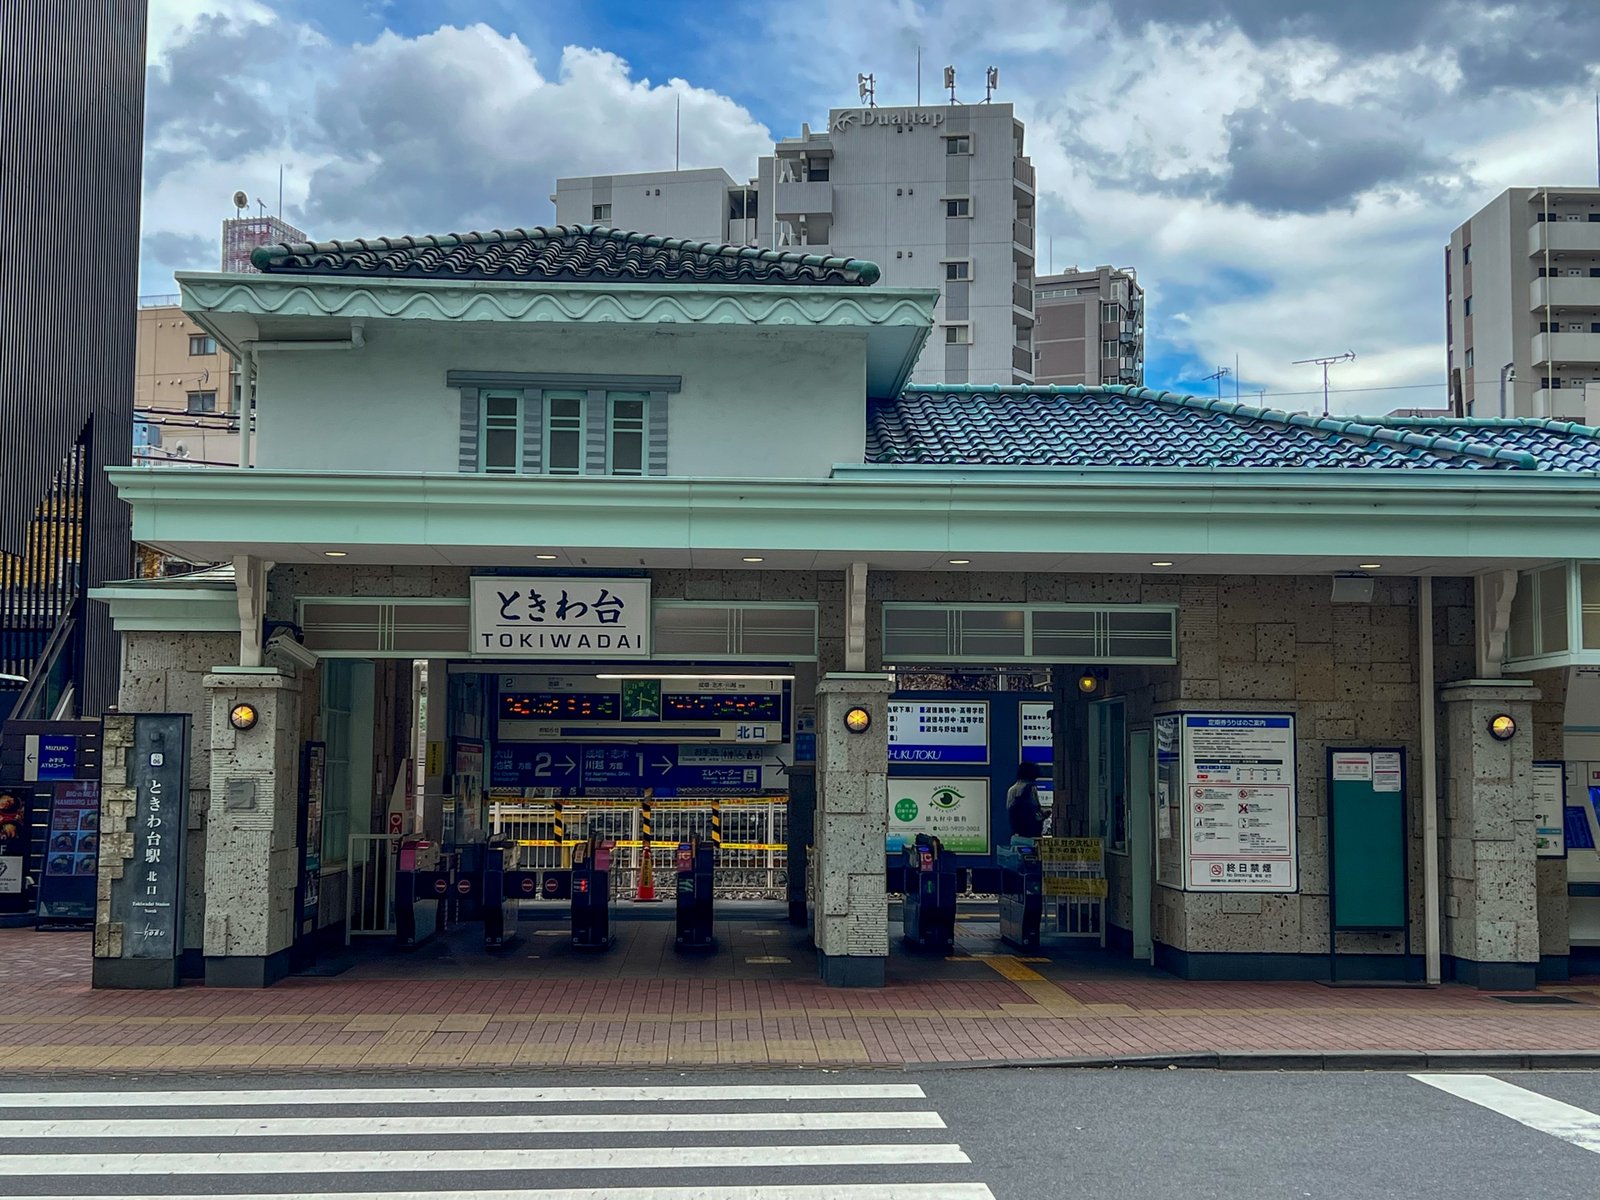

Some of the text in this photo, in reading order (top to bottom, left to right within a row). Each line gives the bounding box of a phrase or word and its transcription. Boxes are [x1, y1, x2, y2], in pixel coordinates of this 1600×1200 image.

[860, 110, 945, 127] Dualtap
[496, 588, 625, 624] ときわ台
[481, 633, 642, 649] TOKIWADAI
[505, 678, 513, 688] 2
[769, 680, 774, 689] 1
[737, 725, 766, 739] 北口
[888, 749, 942, 760] HUKUTOKU
[534, 751, 553, 777] 2
[585, 760, 605, 770] 川越
[635, 751, 645, 777] 1
[145, 779, 162, 864] ときわ台駅
[920, 853, 932, 862] IC
[1226, 863, 1272, 873] 終日禁煙
[146, 870, 158, 895] 北口
